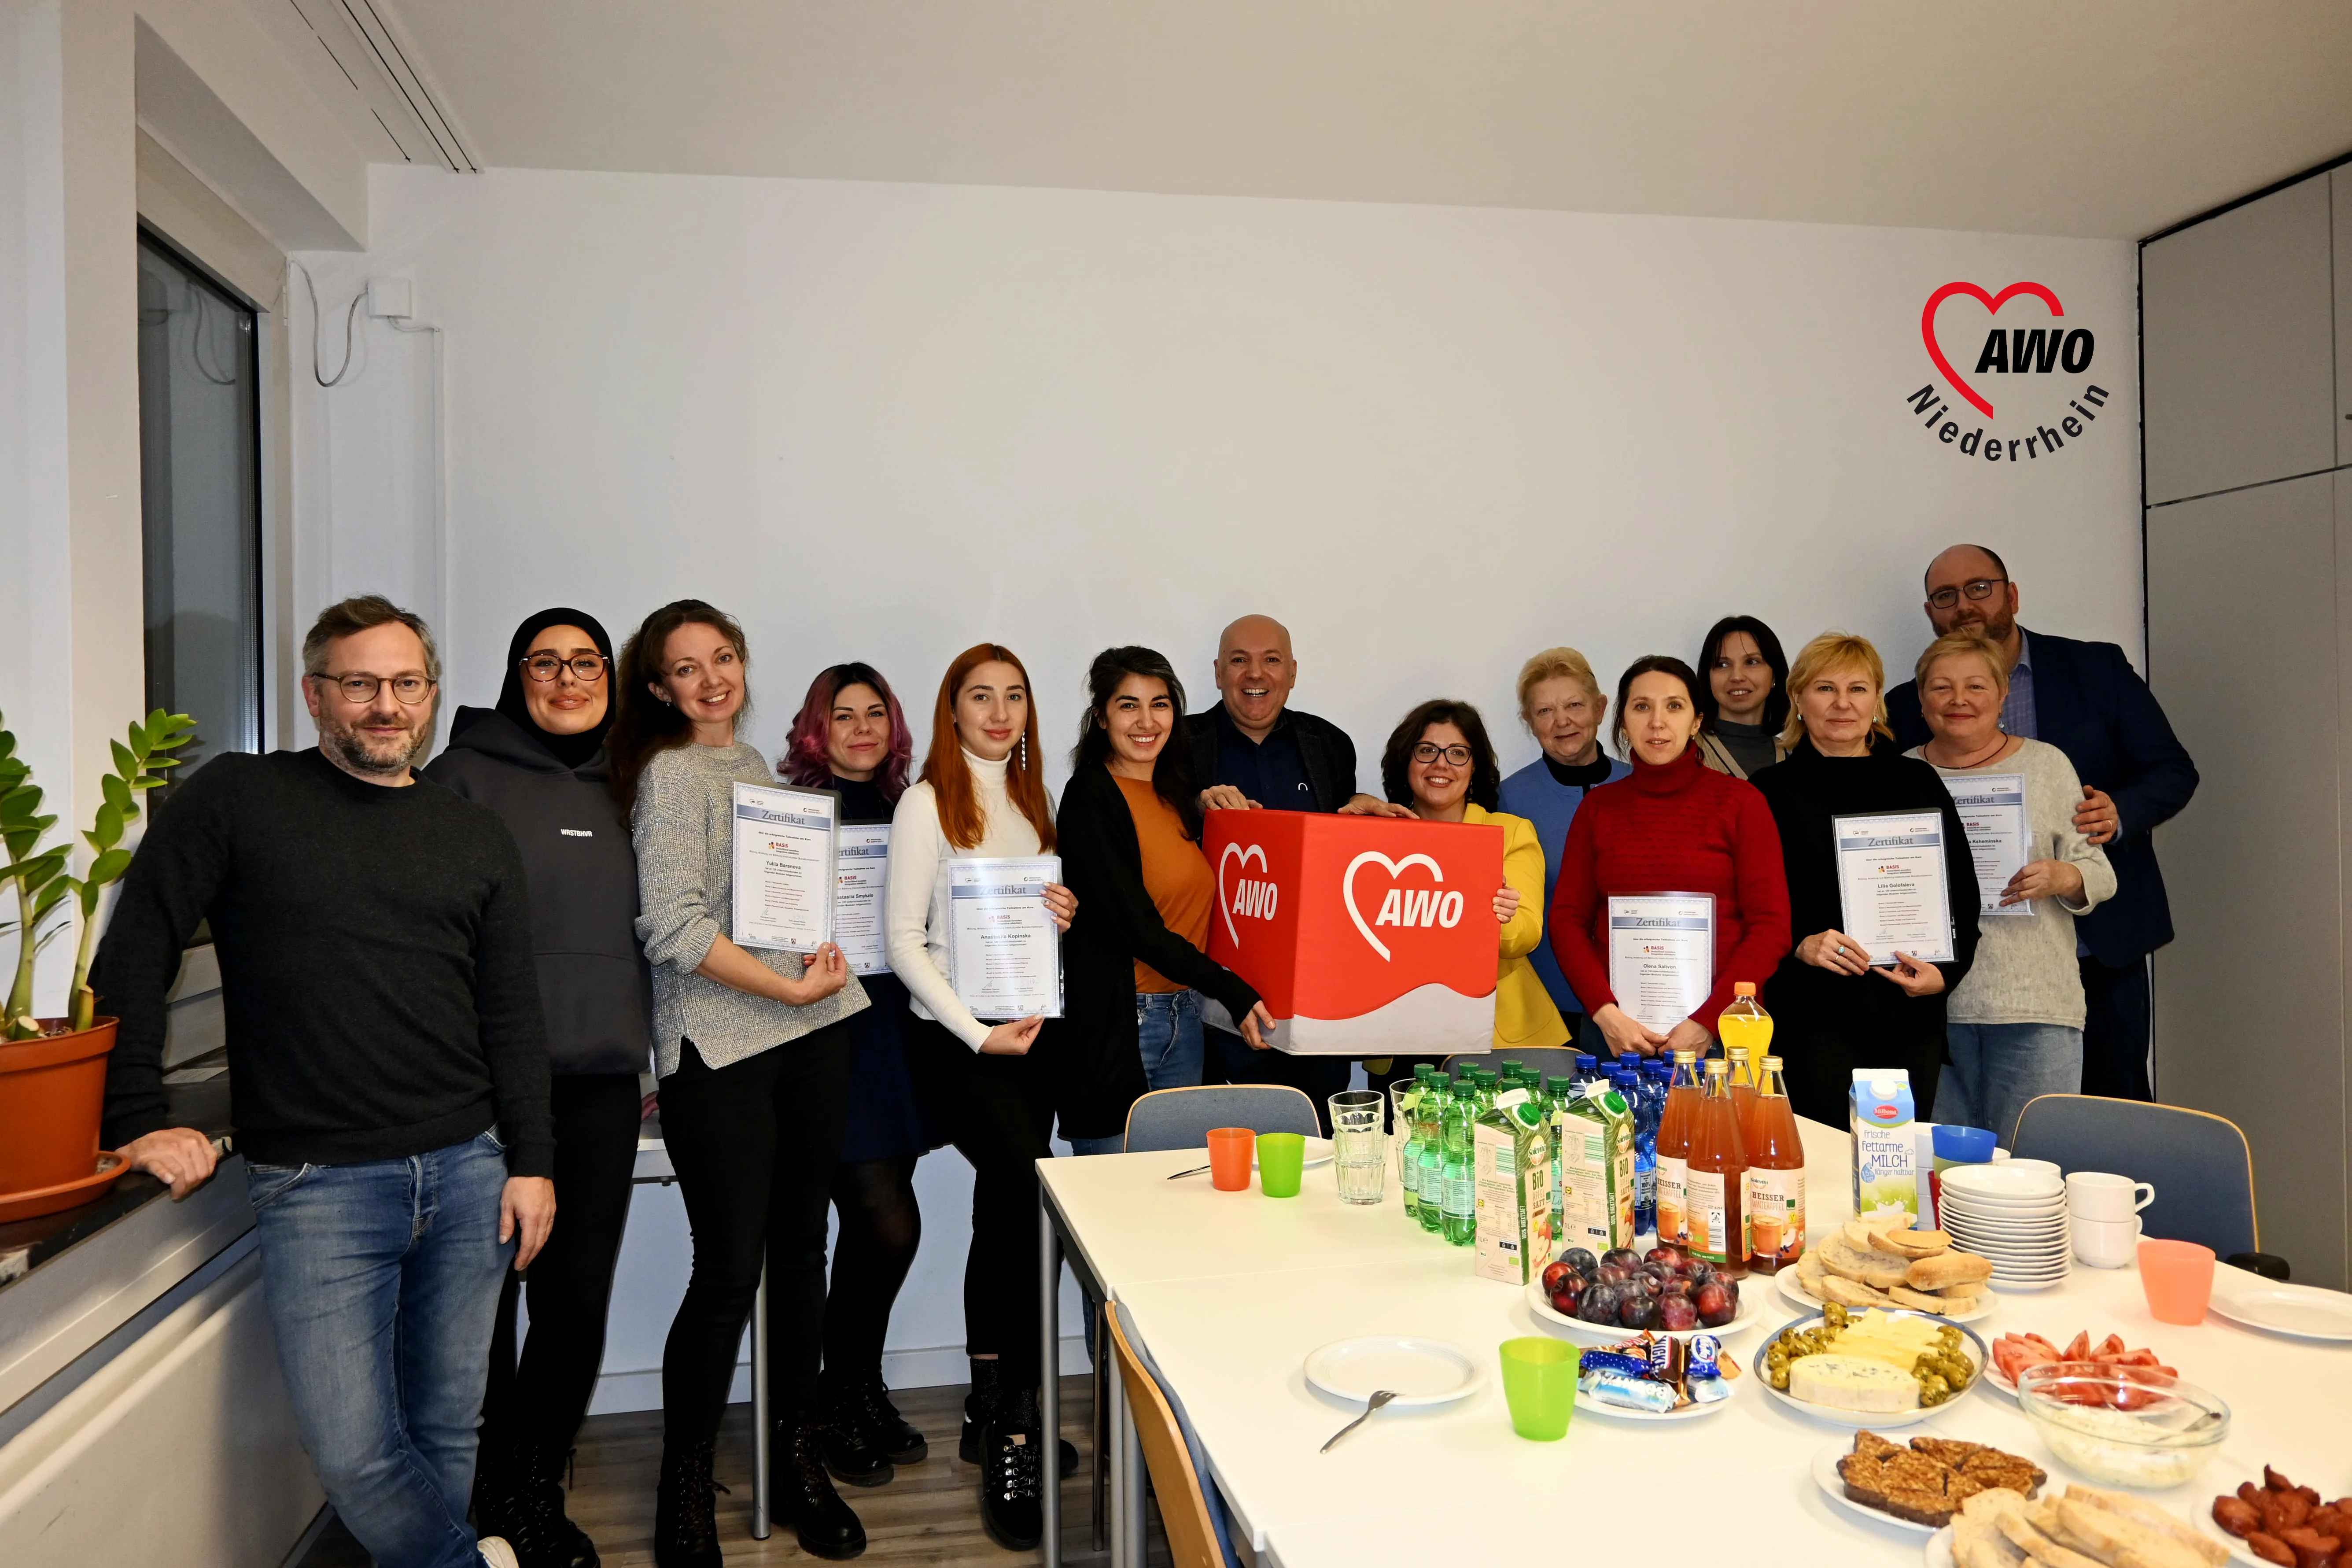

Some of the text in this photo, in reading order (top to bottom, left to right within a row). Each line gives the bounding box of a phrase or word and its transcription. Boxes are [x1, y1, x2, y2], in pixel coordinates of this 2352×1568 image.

[762, 810, 805, 825] Zertifikat
[560, 828, 593, 837] WRSTBHVR
[1868, 836, 1914, 846] Zertifikat
[980, 885, 1027, 895] Zertifikat
[1232, 878, 1278, 921] AWO
[1375, 889, 1464, 928] AWO
[1636, 918, 1681, 927] Zertifikat
[1864, 1130, 1890, 1139] frische
[1529, 1145, 1546, 1157] Solevita
[1862, 1140, 1903, 1153] fettarme
[1872, 1155, 1908, 1168] MILCH
[1875, 1168, 1892, 1177] länger
[1533, 1189, 1545, 1201] APFEL
[1621, 1185, 1630, 1196] SAFT
[1752, 1192, 1784, 1202] HEISSER
[1533, 1199, 1545, 1210] SAFT
[1752, 1200, 1785, 1211] WINTERAPFEL
